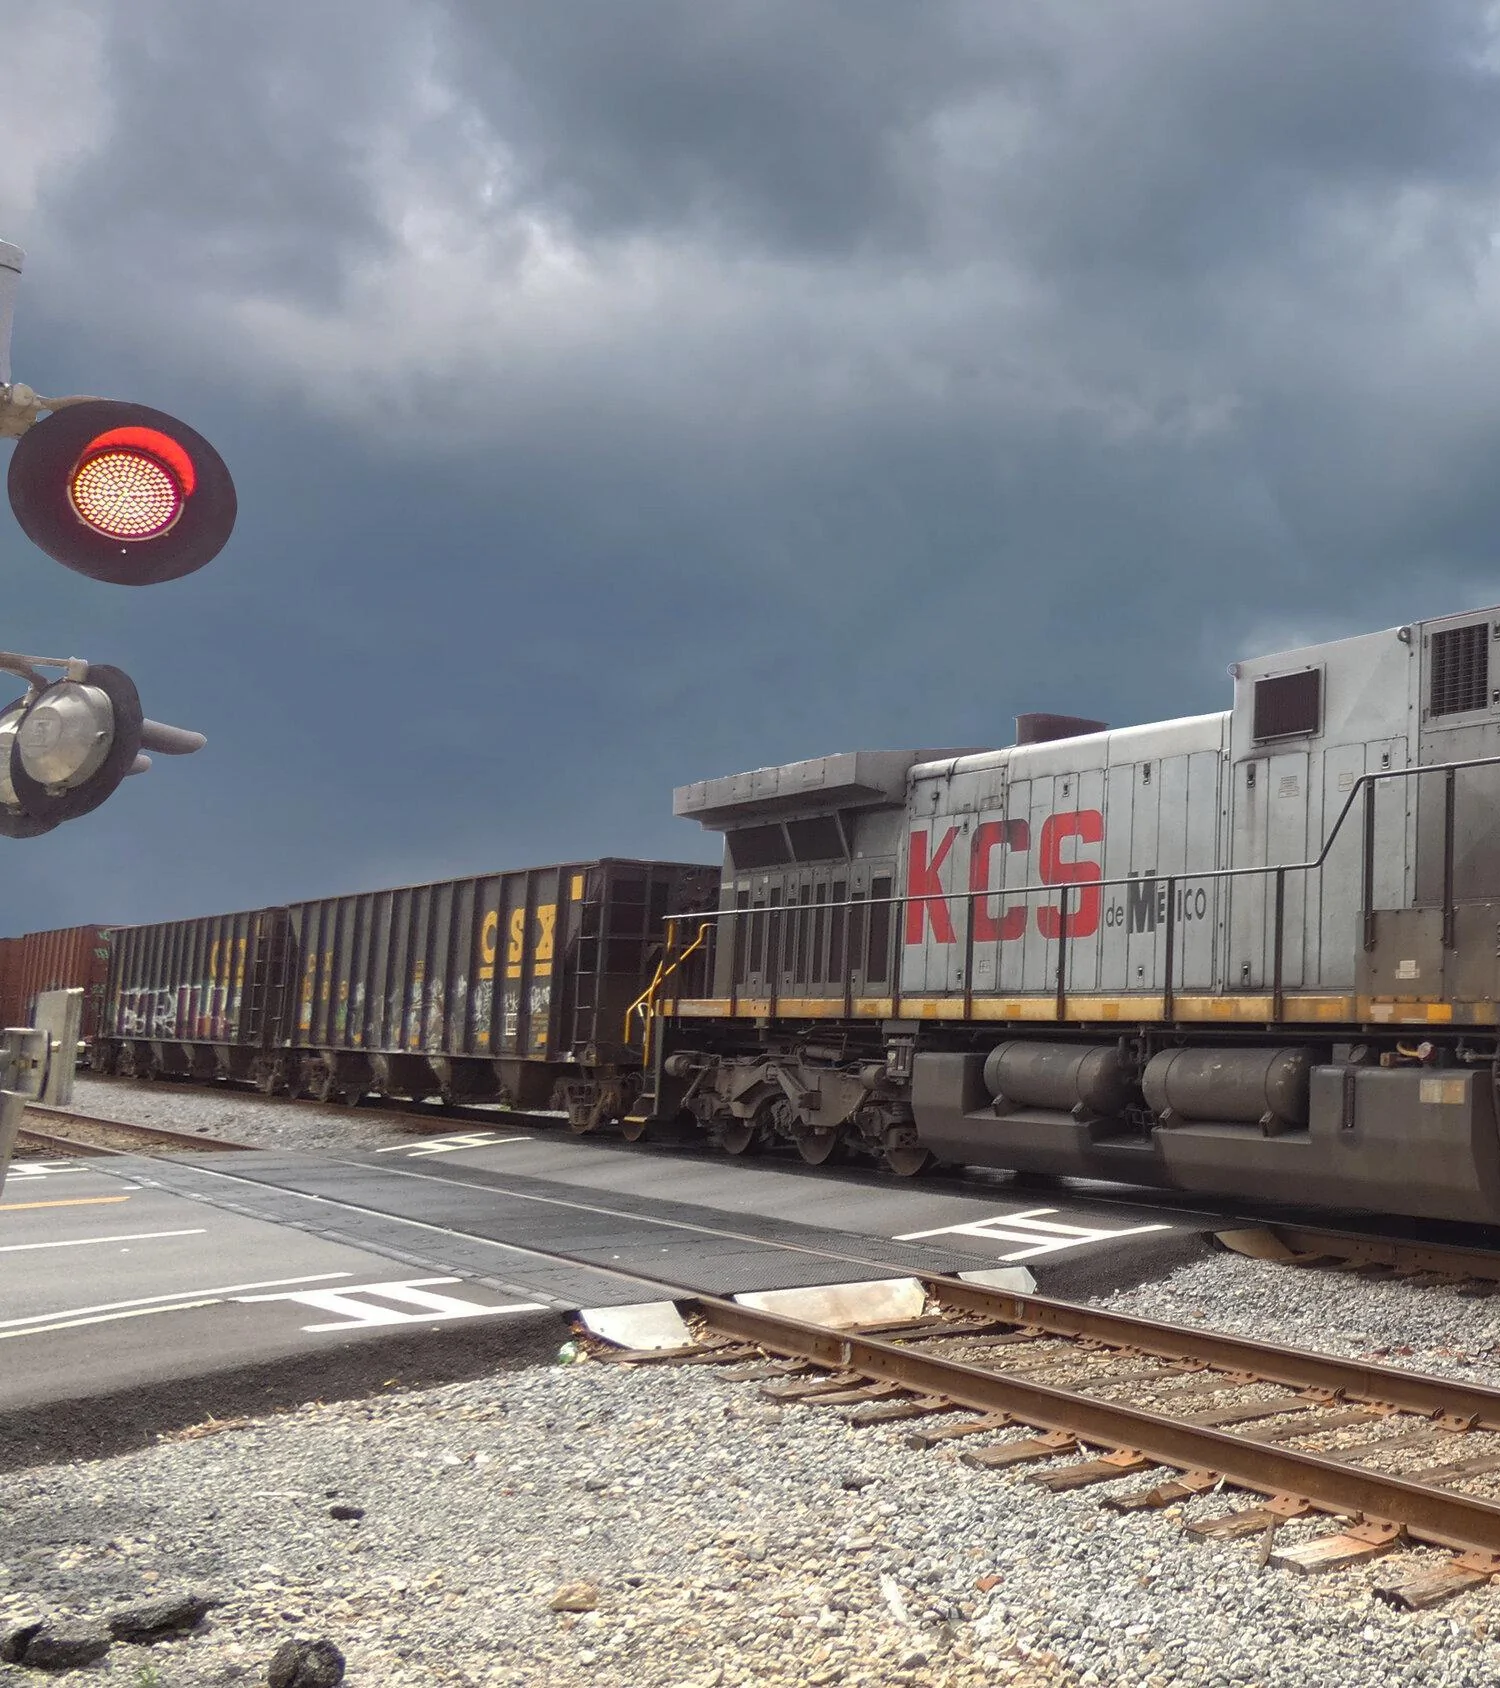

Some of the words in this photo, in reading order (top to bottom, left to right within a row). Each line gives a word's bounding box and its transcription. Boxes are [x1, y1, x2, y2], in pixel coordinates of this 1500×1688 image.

[905, 809, 1104, 945] KCS
[1106, 896, 1124, 927] de
[1126, 869, 1206, 934] MÉICO
[481, 904, 557, 964] CSX
